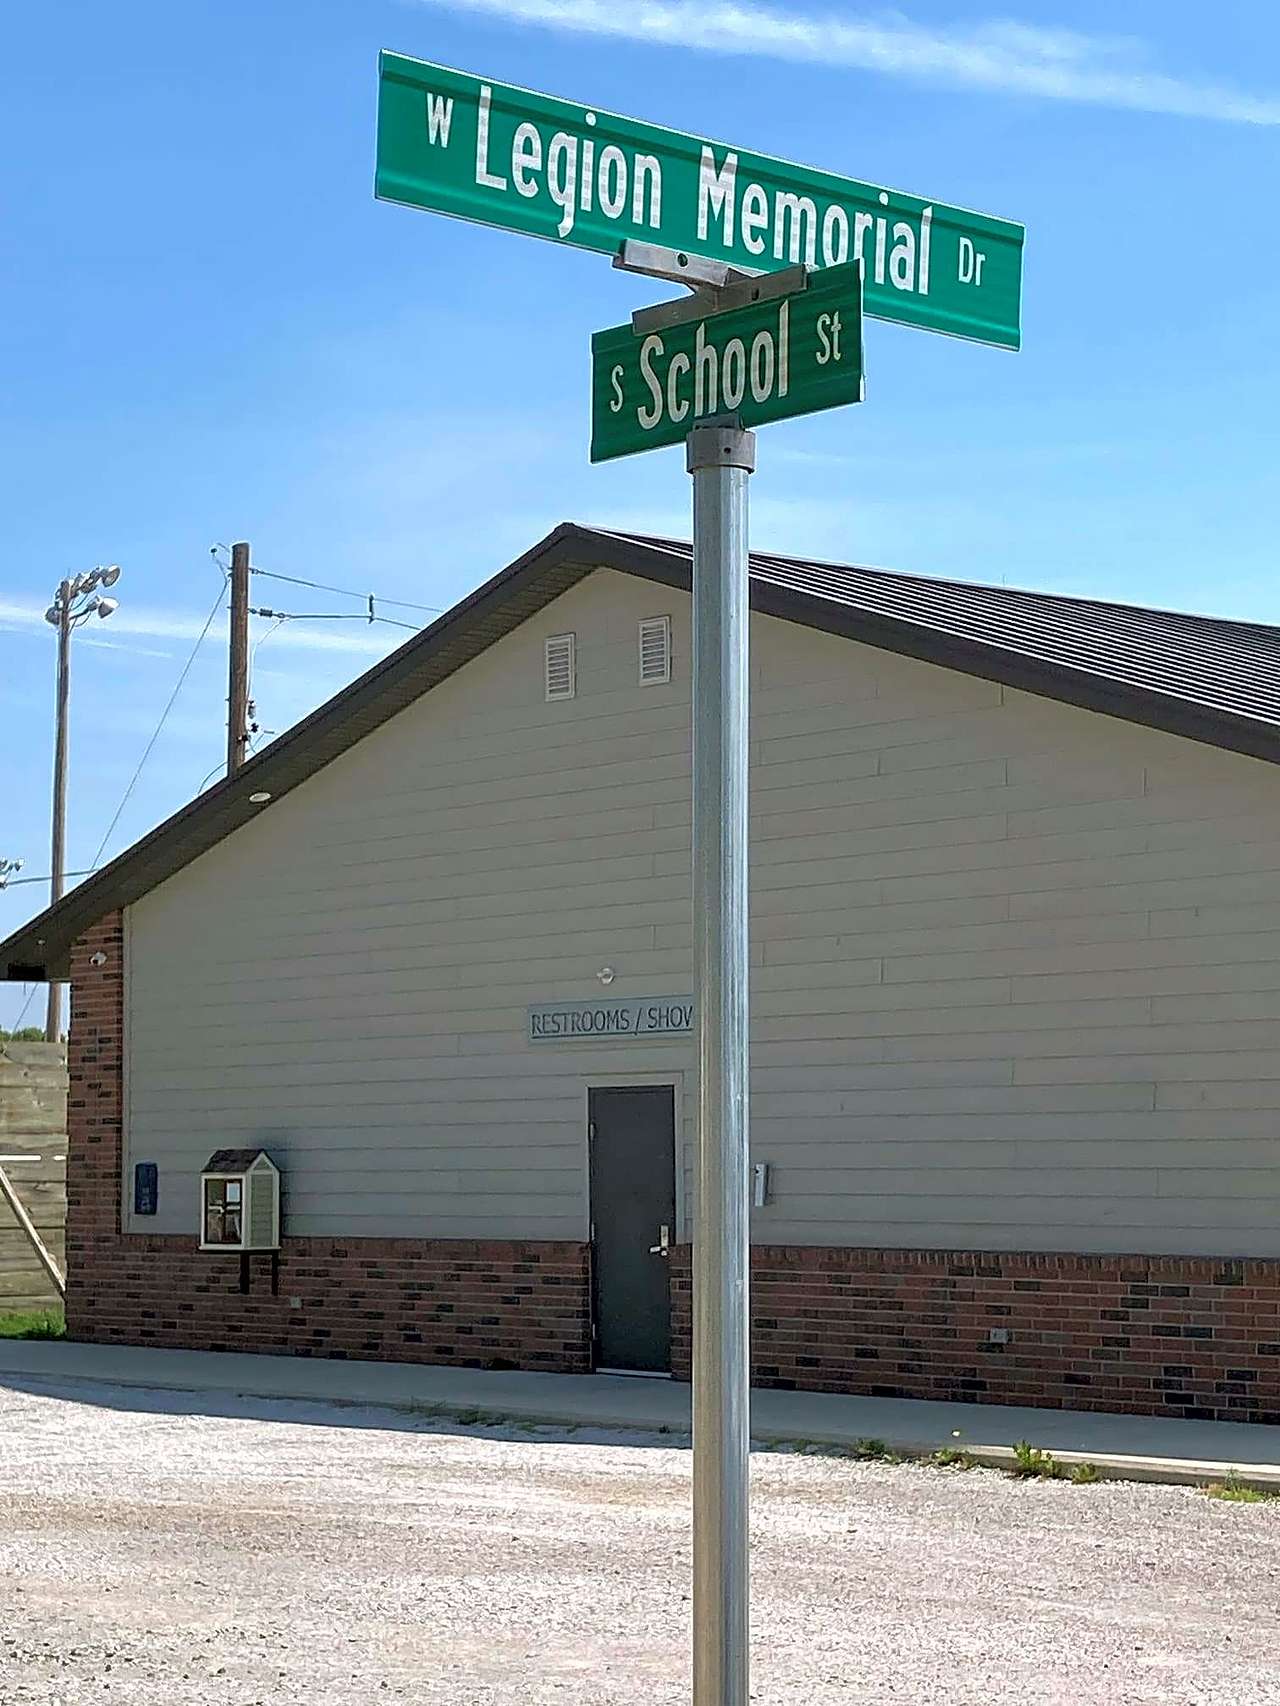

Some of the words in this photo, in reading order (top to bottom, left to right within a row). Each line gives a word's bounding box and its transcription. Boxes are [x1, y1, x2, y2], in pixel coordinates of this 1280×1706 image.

[427, 92, 454, 148] W
[475, 85, 662, 237] Legion
[697, 145, 934, 296] Memorial
[957, 236, 987, 287] Dr
[611, 364, 625, 412] S
[637, 300, 789, 430] School
[816, 310, 842, 364] St
[531, 1009, 630, 1035] RESTROOMS
